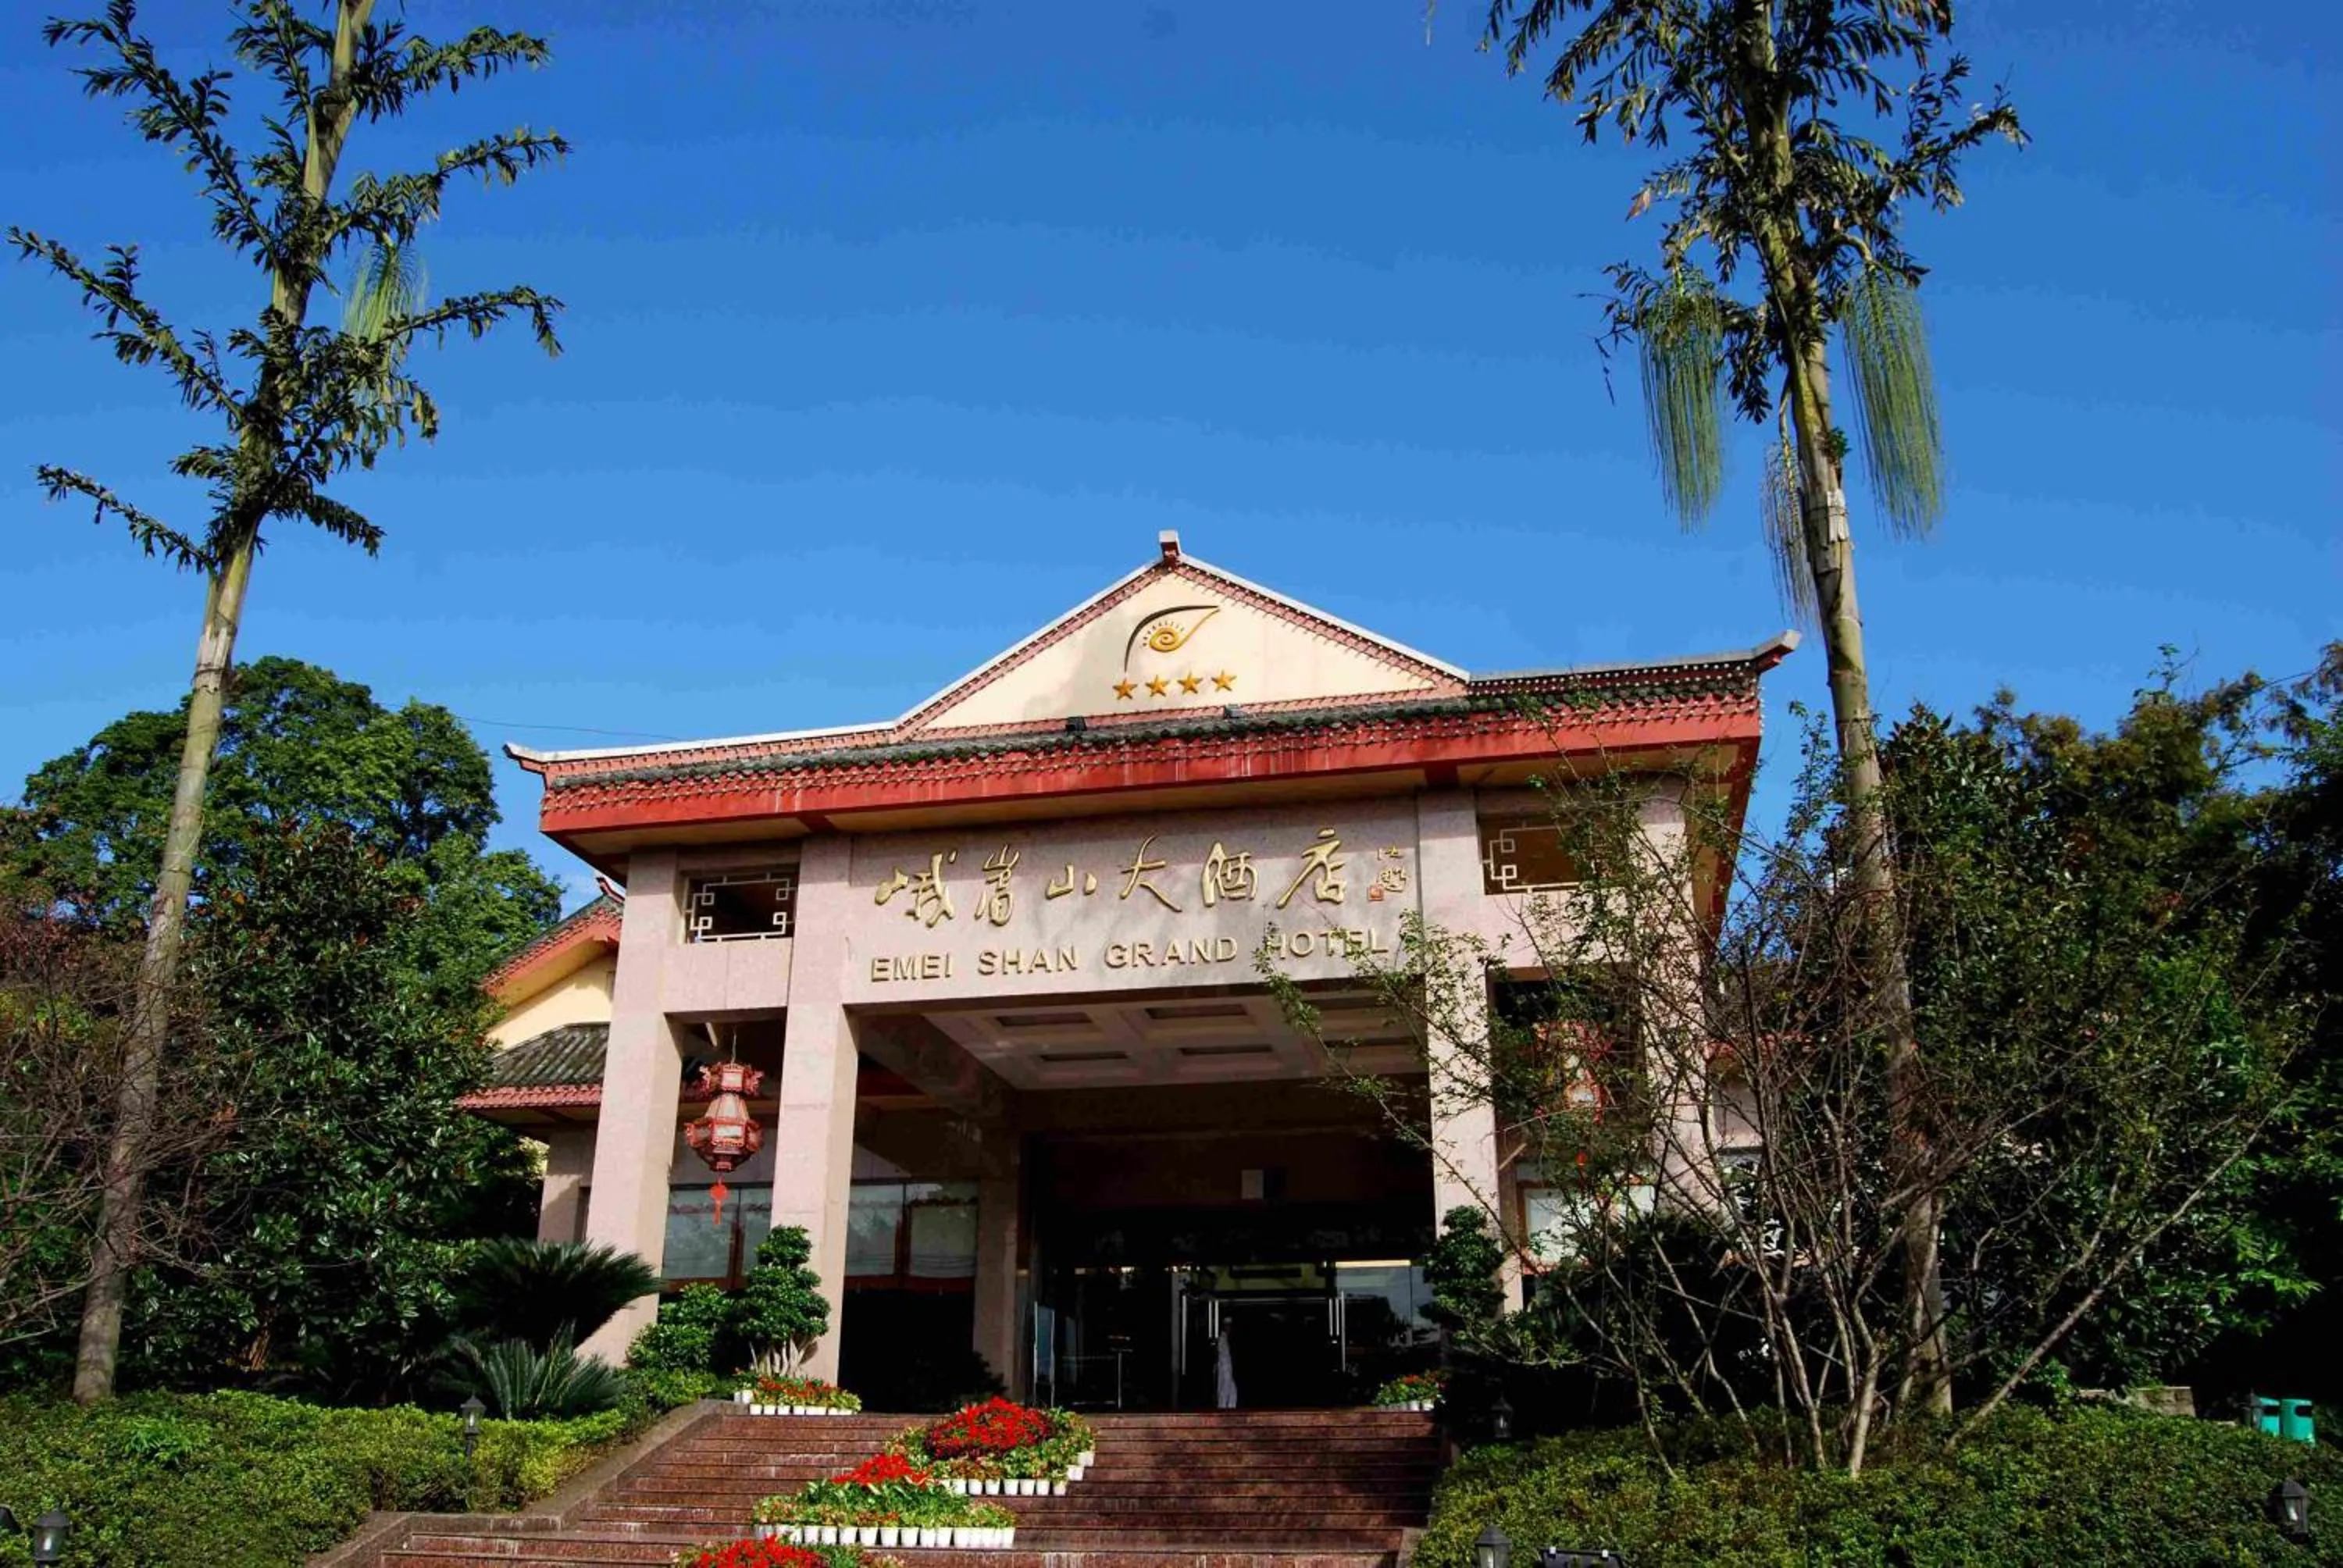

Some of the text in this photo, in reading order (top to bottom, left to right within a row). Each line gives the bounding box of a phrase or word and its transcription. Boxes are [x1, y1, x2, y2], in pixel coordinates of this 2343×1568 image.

[871, 952, 952, 982] EMEI
[977, 945, 1079, 976] SHAN
[1104, 936, 1239, 969] GRAND
